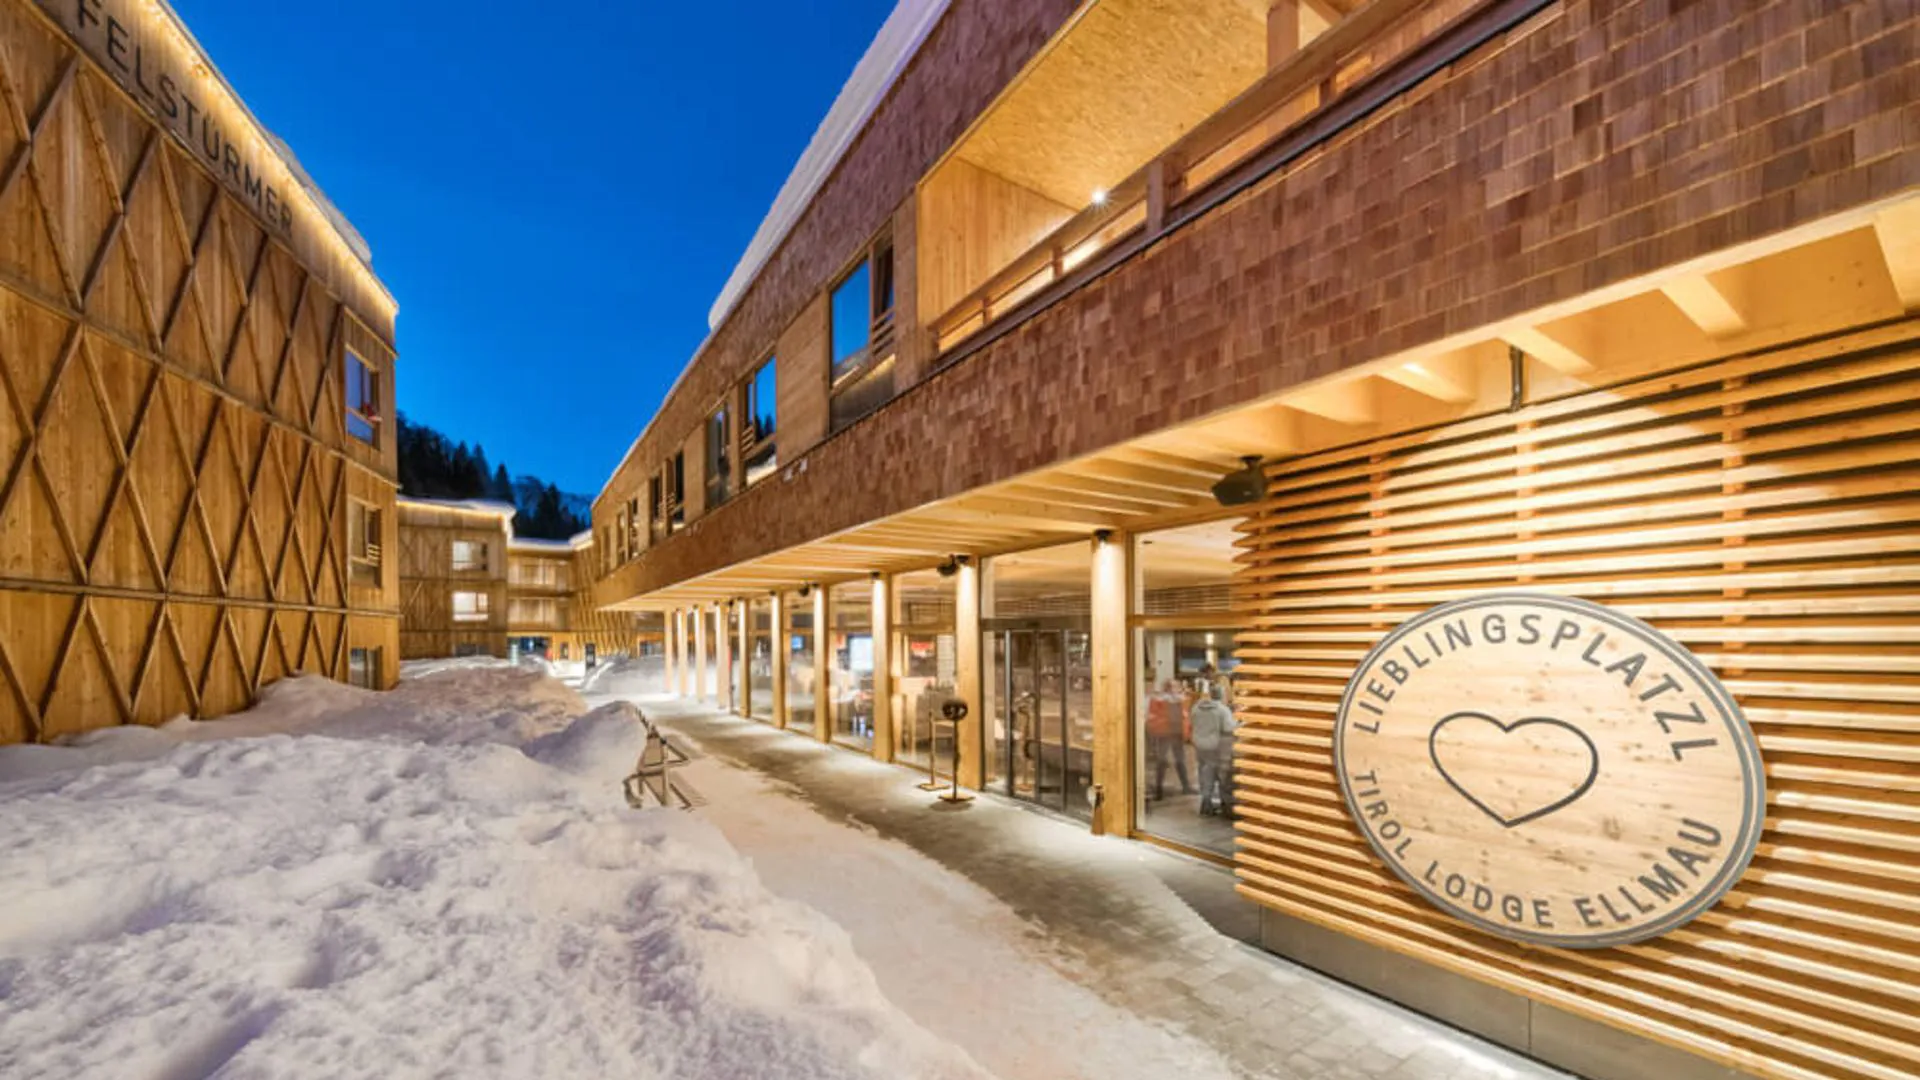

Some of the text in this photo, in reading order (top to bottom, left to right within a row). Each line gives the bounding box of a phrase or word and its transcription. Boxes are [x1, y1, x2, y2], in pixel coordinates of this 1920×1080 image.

[1353, 614, 1718, 761] LIEBLINGSPLATZL
[1354, 770, 1722, 928] TIROL LODGE ELLMAU
